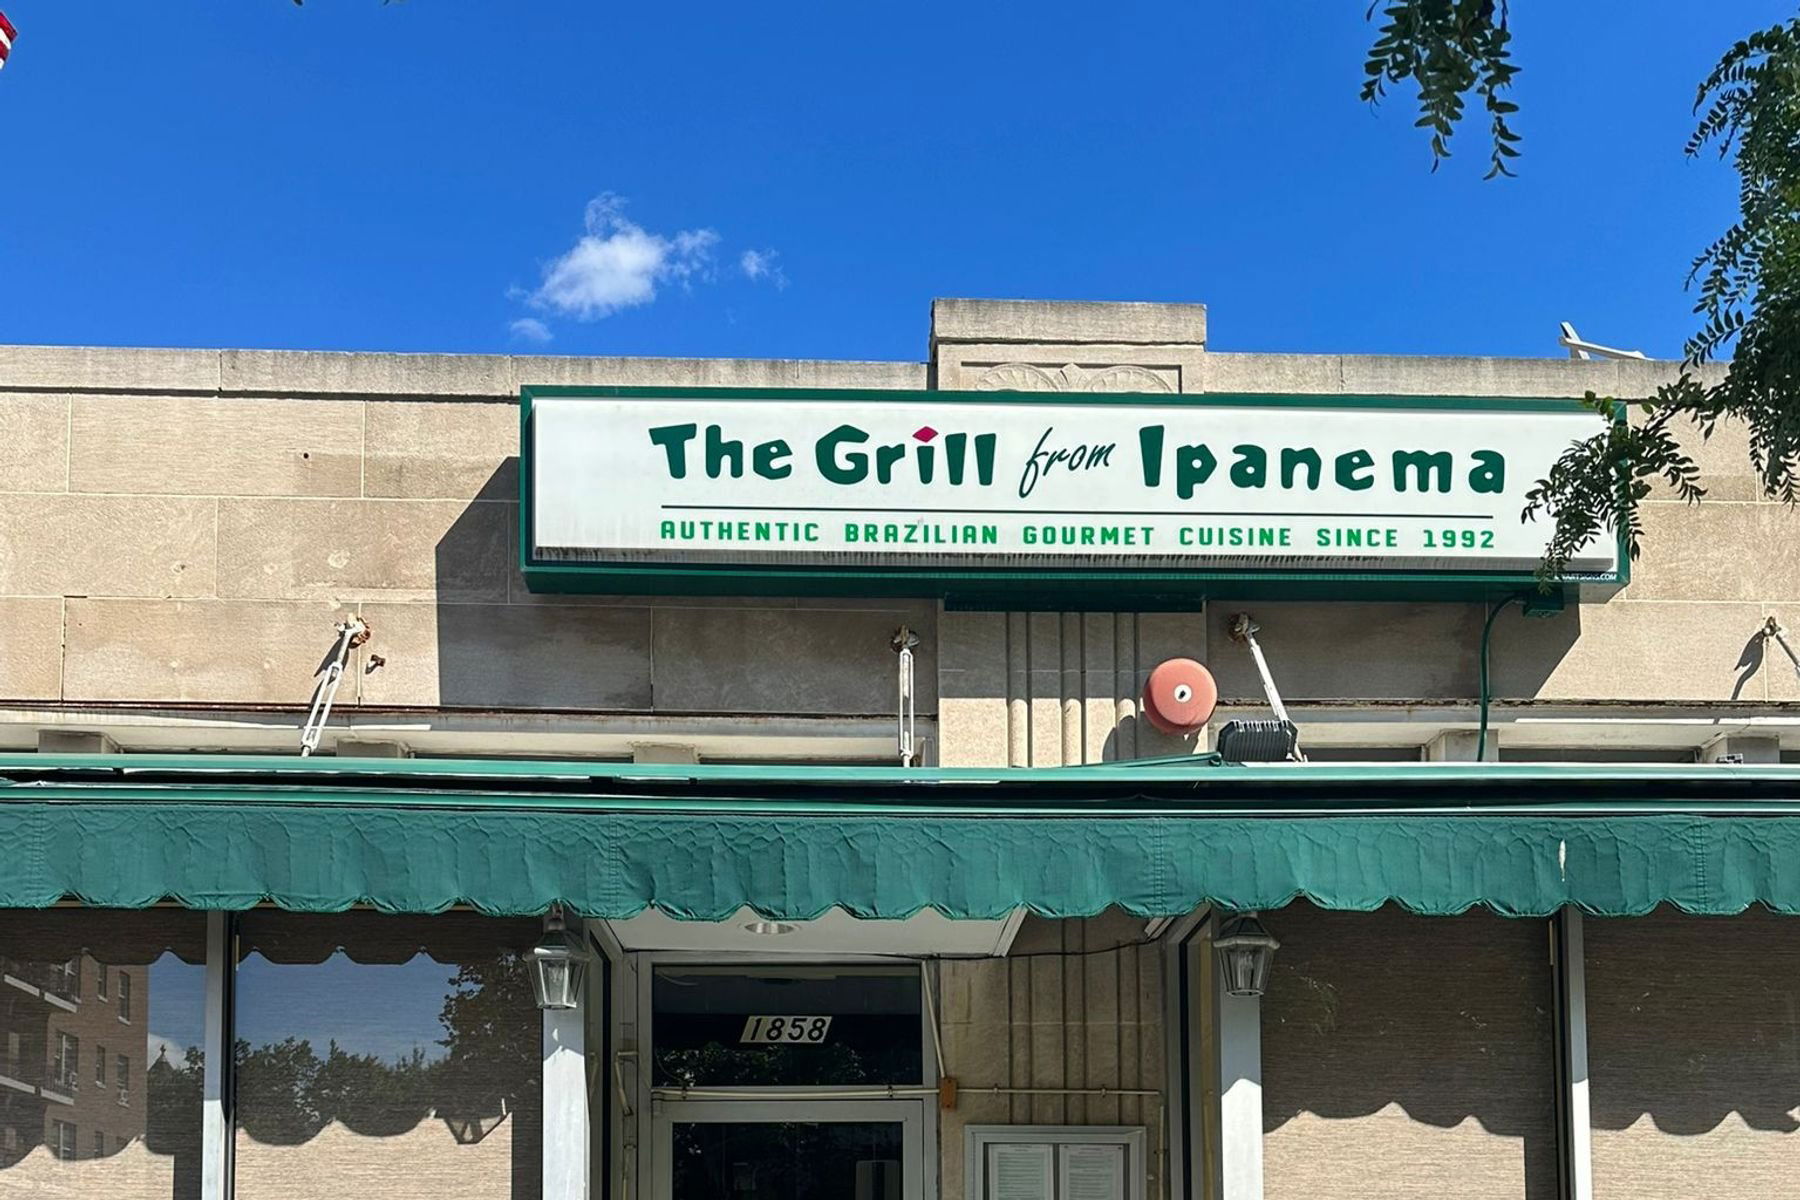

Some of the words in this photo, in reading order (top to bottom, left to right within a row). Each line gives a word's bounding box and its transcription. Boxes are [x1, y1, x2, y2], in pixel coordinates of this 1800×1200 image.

[649, 423, 793, 480] The
[815, 425, 997, 487] Grill
[1019, 427, 1116, 498] from
[1139, 425, 1505, 500] Ipanema
[660, 520, 819, 543] AUTHENTIC
[845, 522, 998, 545] BRAZILIAN
[1023, 525, 1155, 546] GOURMET
[1180, 527, 1291, 547] CUISINE
[1317, 528, 1398, 548] SINCE
[1424, 529, 1495, 549] 1992
[750, 1017, 827, 1041] 1858
